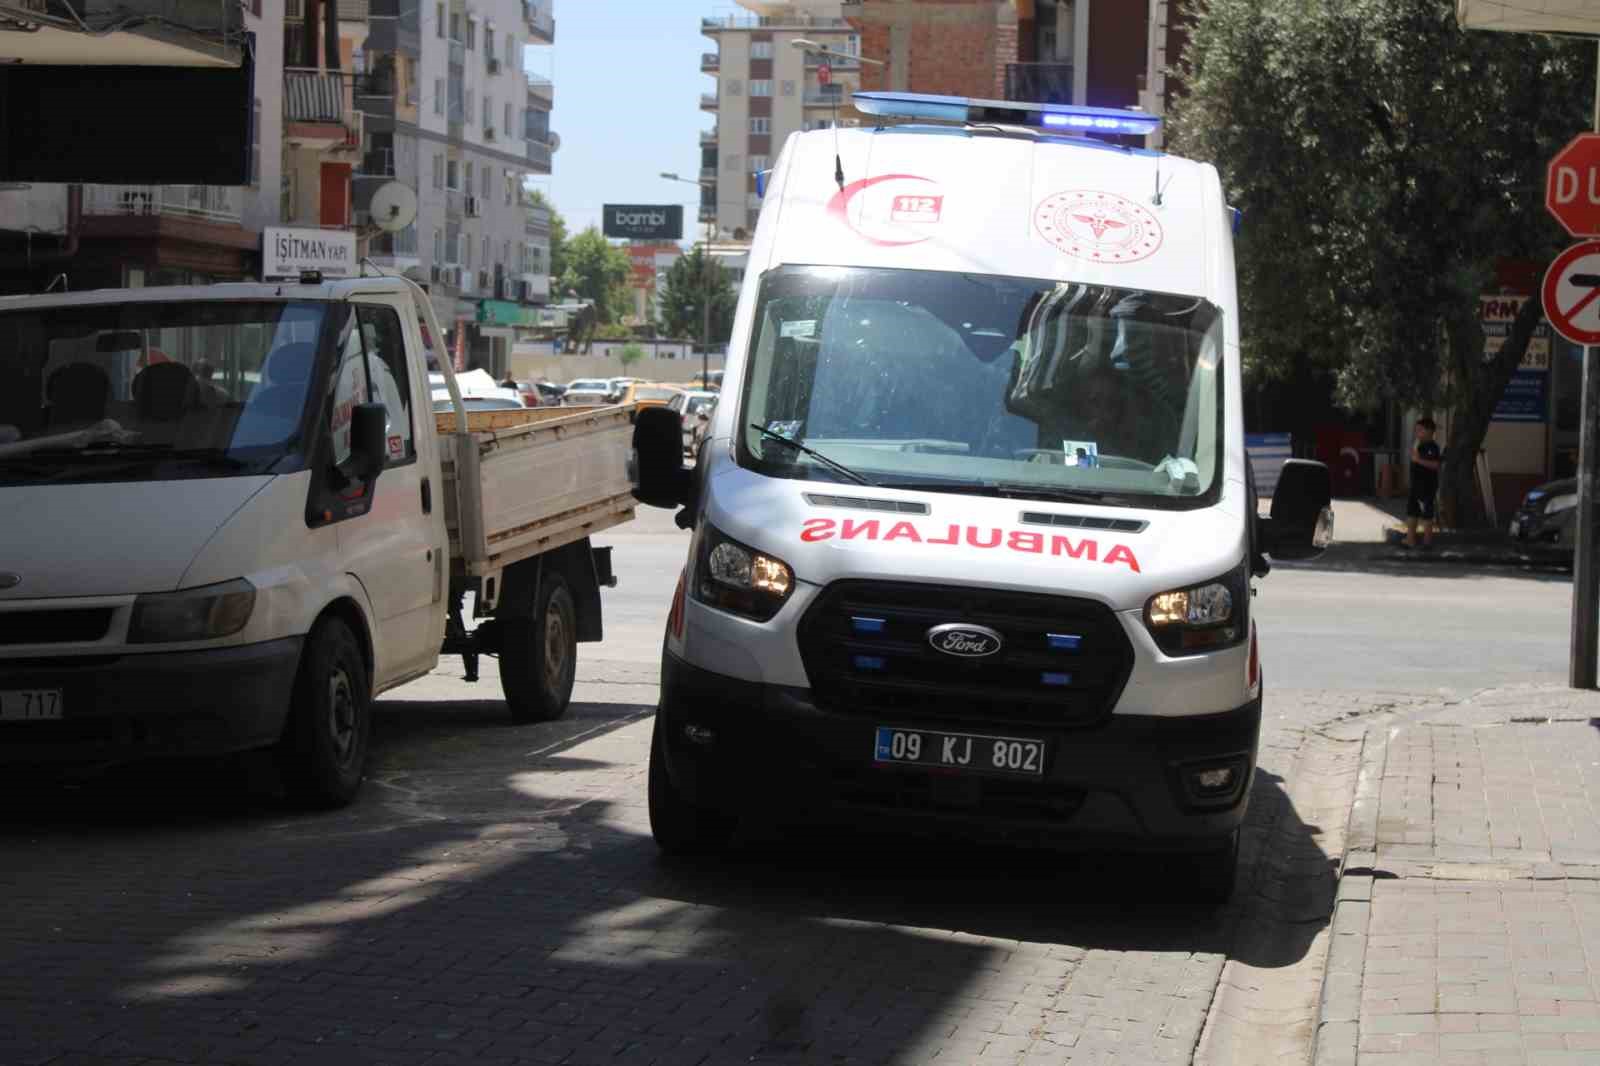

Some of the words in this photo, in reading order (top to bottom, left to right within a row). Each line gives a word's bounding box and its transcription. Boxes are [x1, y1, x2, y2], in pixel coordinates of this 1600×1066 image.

[898, 198, 935, 211] 112
[616, 208, 665, 225] bambi
[276, 232, 326, 262] İŞİTMAN
[943, 631, 987, 652] Ford
[22, 692, 57, 716] 717
[892, 732, 921, 760] 09
[942, 736, 973, 764] KJ
[993, 740, 1038, 771] 802
